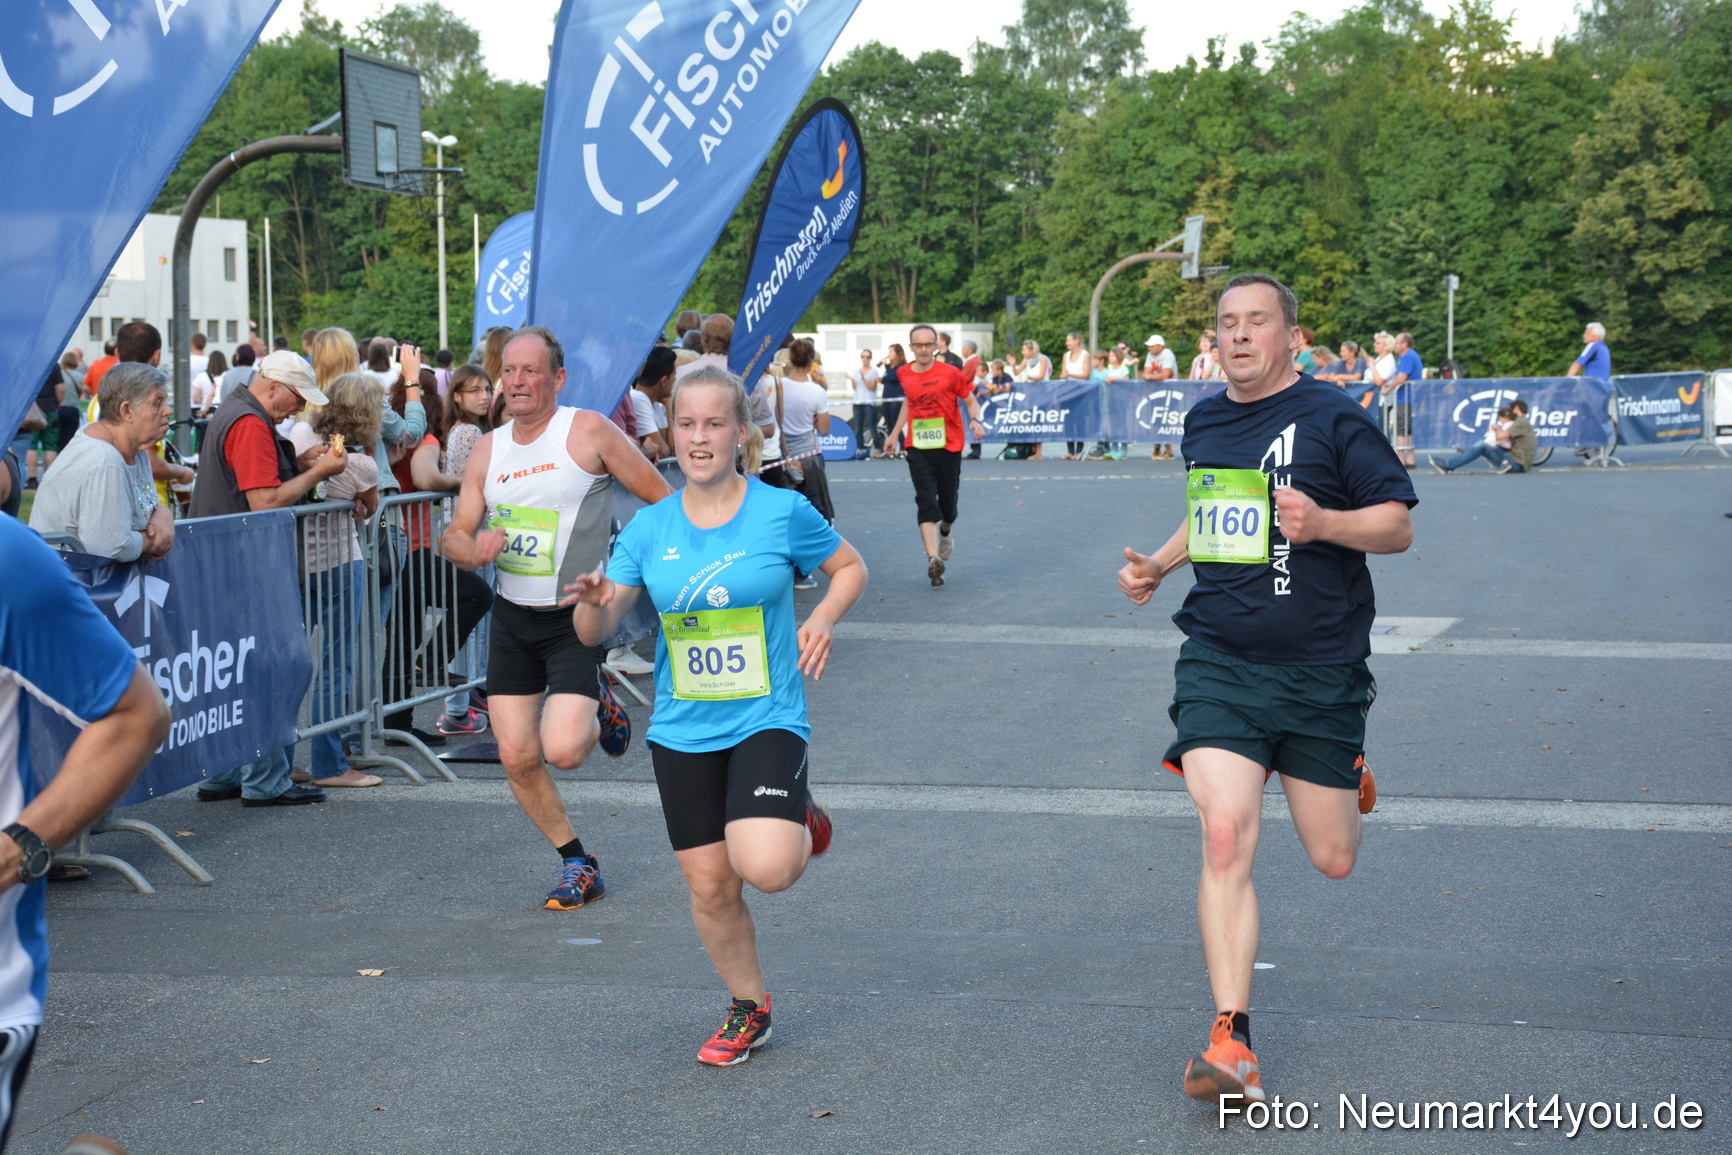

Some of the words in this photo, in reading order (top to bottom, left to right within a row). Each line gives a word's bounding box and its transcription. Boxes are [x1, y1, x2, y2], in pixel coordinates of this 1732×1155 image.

[699, 0, 809, 165] AUTOMOB
[830, 190, 858, 236] Medien
[744, 205, 828, 333] Frischmann
[994, 406, 1070, 425] Fischer
[1150, 406, 1189, 425] Fisc
[1475, 406, 1578, 428] Fiher
[1617, 395, 1681, 417] Frischmann
[916, 429, 943, 441] 1480
[998, 424, 1064, 434] AUTOMOBILE
[1157, 426, 1185, 435] AUTO
[513, 463, 560, 480] KLEBL
[1195, 506, 1259, 537] 1160
[671, 585, 690, 611] Team
[688, 560, 722, 585] Schick
[723, 549, 746, 562] Bau
[687, 645, 746, 676] 805
